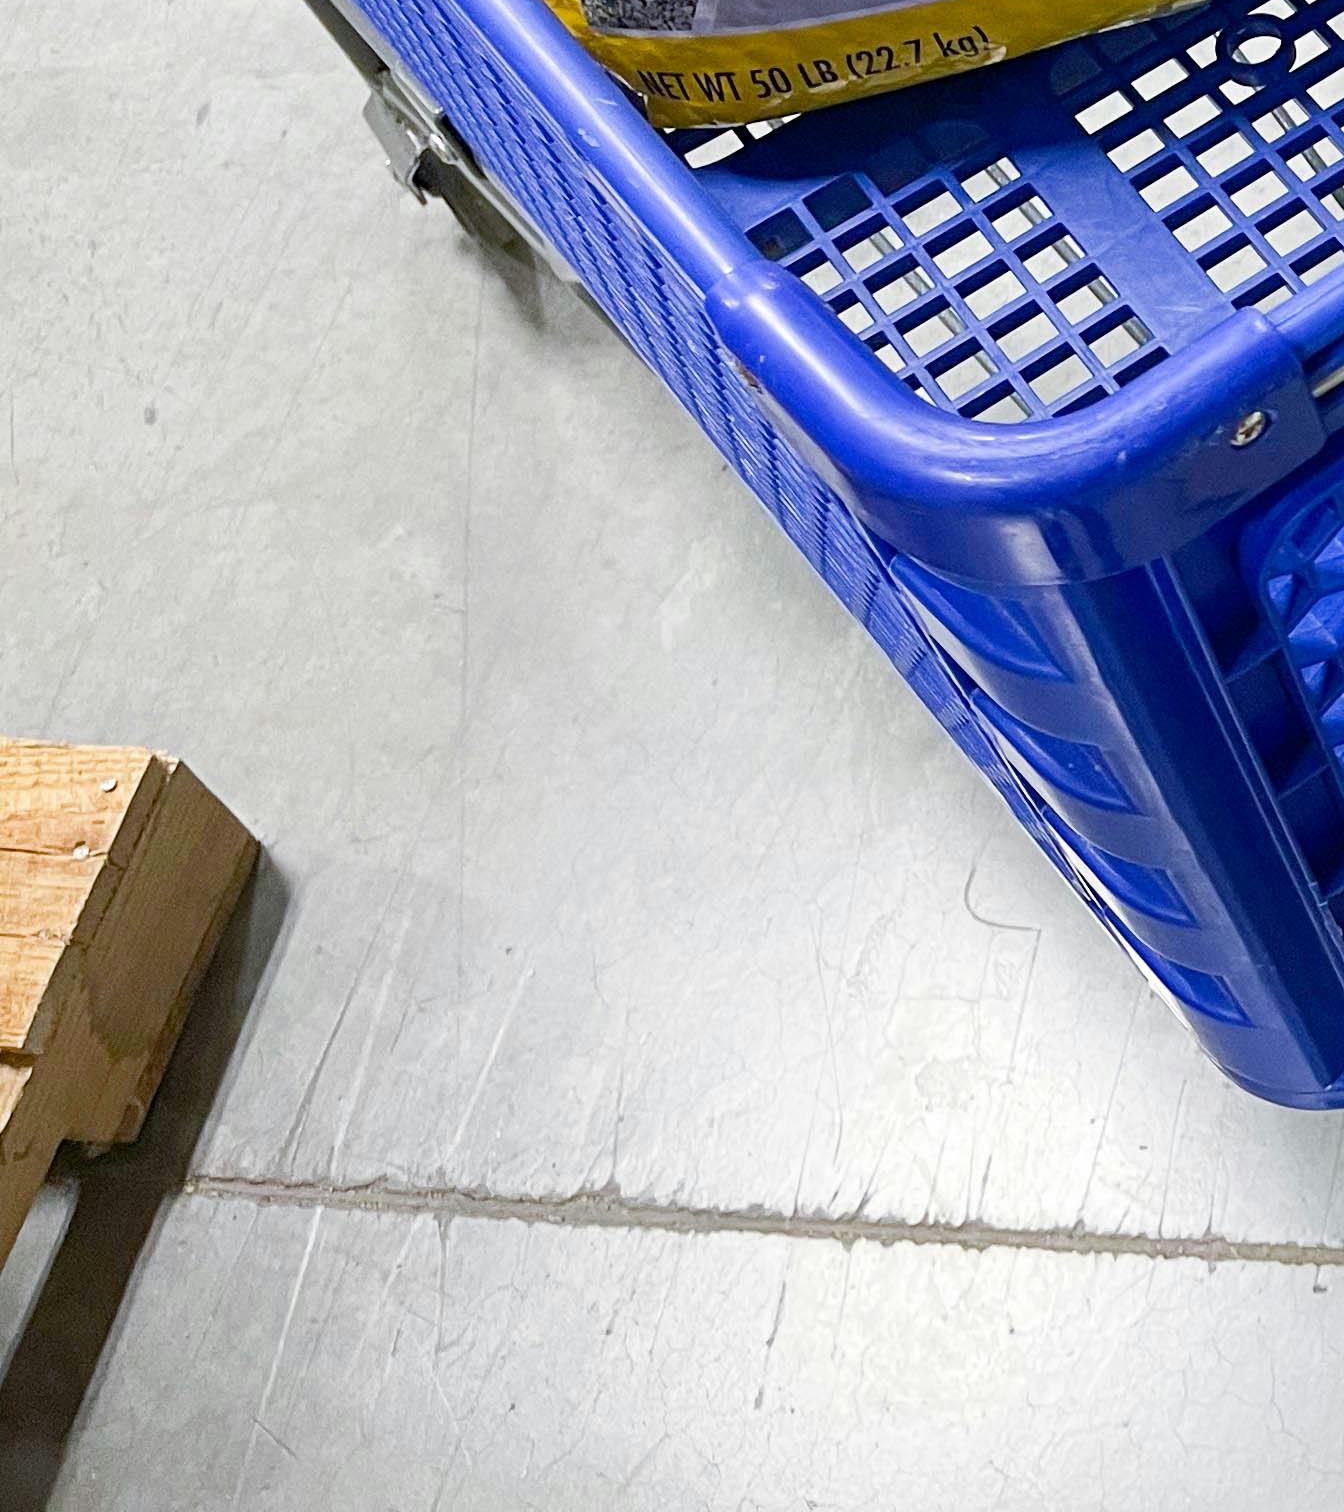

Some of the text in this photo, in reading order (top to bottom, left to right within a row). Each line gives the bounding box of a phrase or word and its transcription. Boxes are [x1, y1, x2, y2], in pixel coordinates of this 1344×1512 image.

[636, 24, 991, 103] NET WT 50 LB (22.7 kg)
